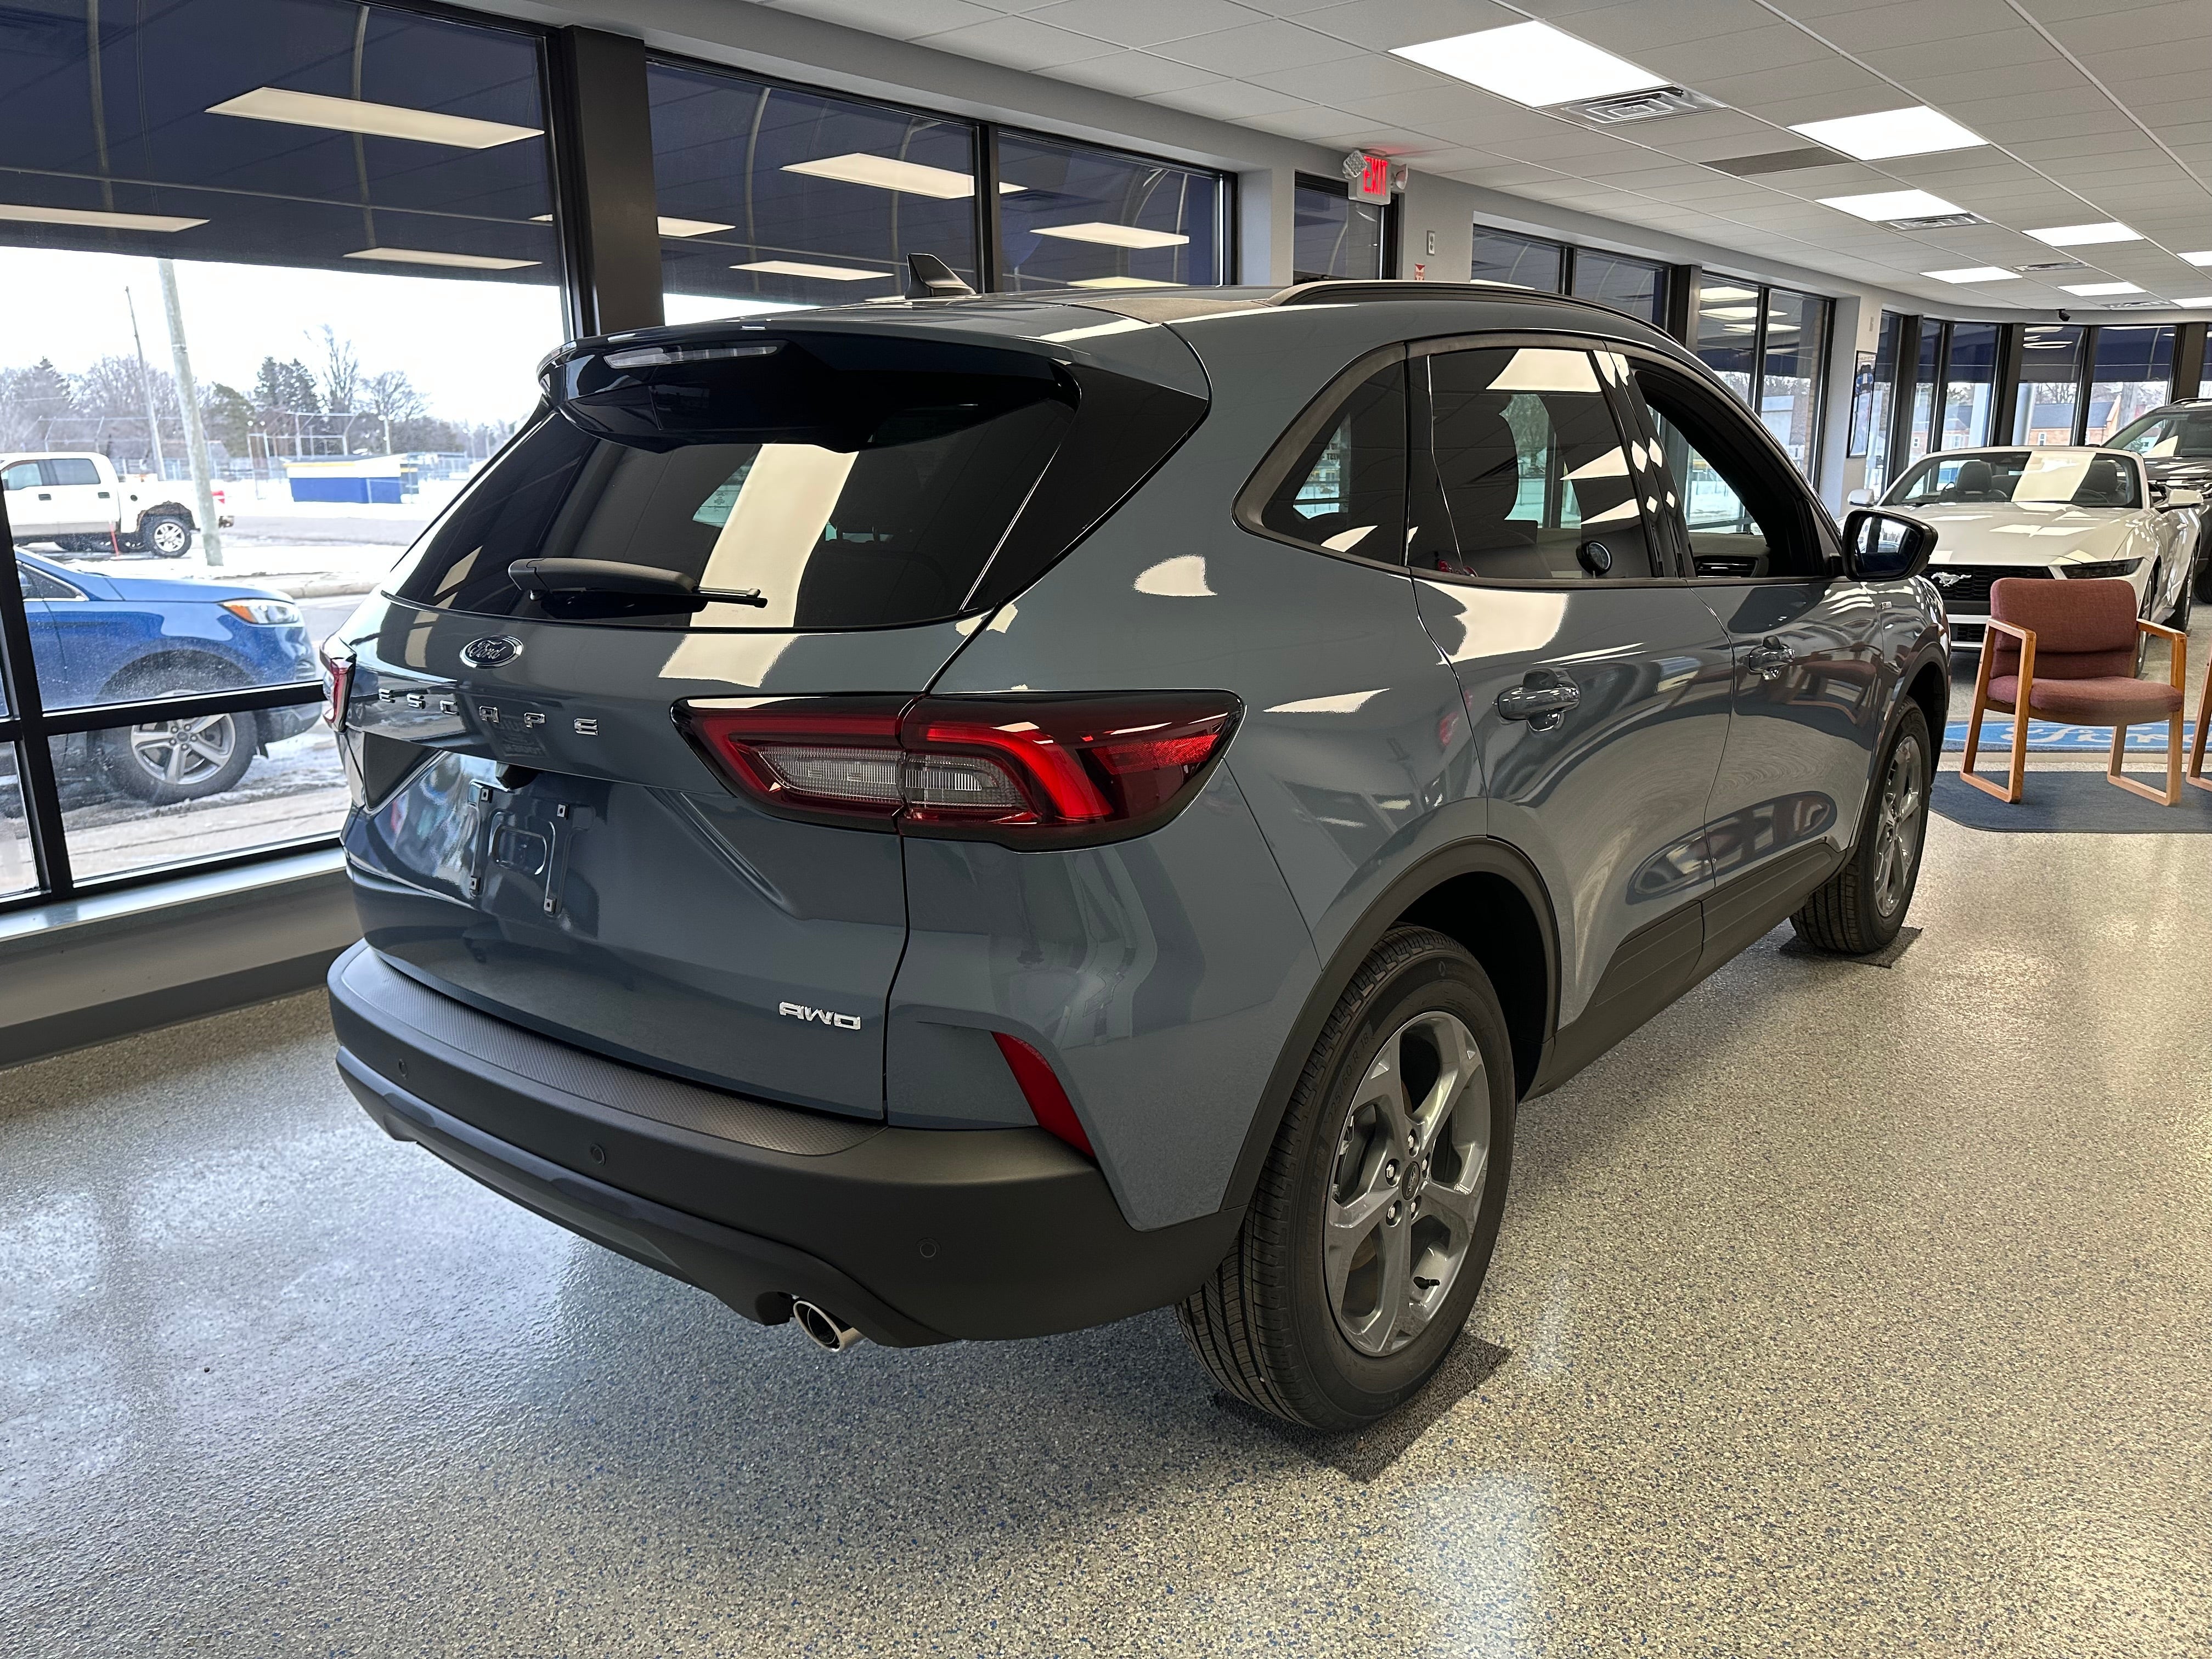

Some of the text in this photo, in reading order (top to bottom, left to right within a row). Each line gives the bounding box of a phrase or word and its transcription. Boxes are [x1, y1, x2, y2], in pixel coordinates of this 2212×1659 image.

[1363, 156, 1388, 196] EXIT
[378, 688, 599, 736] ESCAPE
[779, 1002, 861, 1030] AWD
[1328, 1032, 1369, 1123] 225/60 R 18
